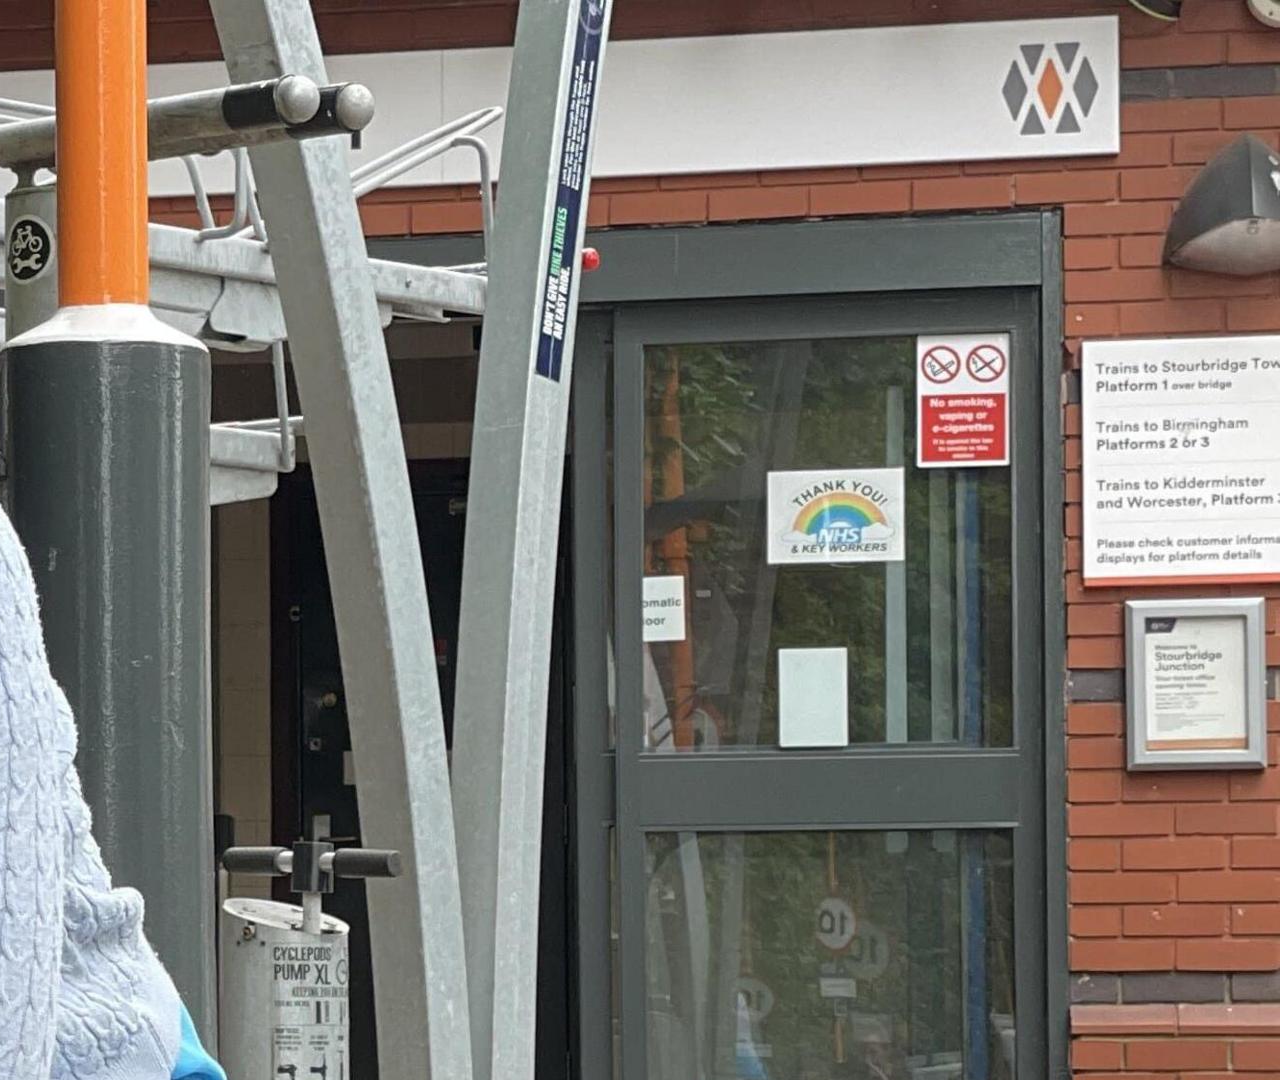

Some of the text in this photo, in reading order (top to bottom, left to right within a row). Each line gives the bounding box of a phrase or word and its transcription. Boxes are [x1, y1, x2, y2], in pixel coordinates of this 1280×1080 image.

[542, 206, 568, 337] DON'T GIVE BIKE THIEVES
[555, 293, 569, 322] EASY
[553, 322, 564, 341] AN
[1096, 362, 1139, 375] Trains
[1143, 362, 1158, 374] to
[1161, 358, 1248, 373] Stourbridge
[1096, 379, 1232, 392] Platform 1 over bridge
[929, 398, 946, 408] No
[938, 411, 988, 422] vaping or
[932, 423, 995, 434] e-cigarettes
[1096, 417, 1249, 433] Trains to Birmingham
[1096, 436, 1211, 451] Platforms 2 or 3
[1096, 475, 1266, 491] Trains to Kidderminster
[792, 479, 889, 507] THANK YOU!
[1096, 497, 1123, 509] and
[1127, 495, 1207, 509] Worcester,
[1211, 493, 1274, 506] Platform
[818, 527, 860, 543] NHS
[1097, 538, 1135, 549] Please
[1138, 536, 1174, 548] check
[1176, 535, 1233, 547] customer
[791, 542, 888, 554] & KEY WORKERS
[1096, 549, 1263, 566] displays for platform details
[643, 616, 666, 626] oor
[1154, 650, 1223, 662] Stourbridge
[1154, 661, 1206, 672] Junction
[273, 946, 333, 962] CYCLEPODS
[273, 963, 332, 985] PUMP XL
